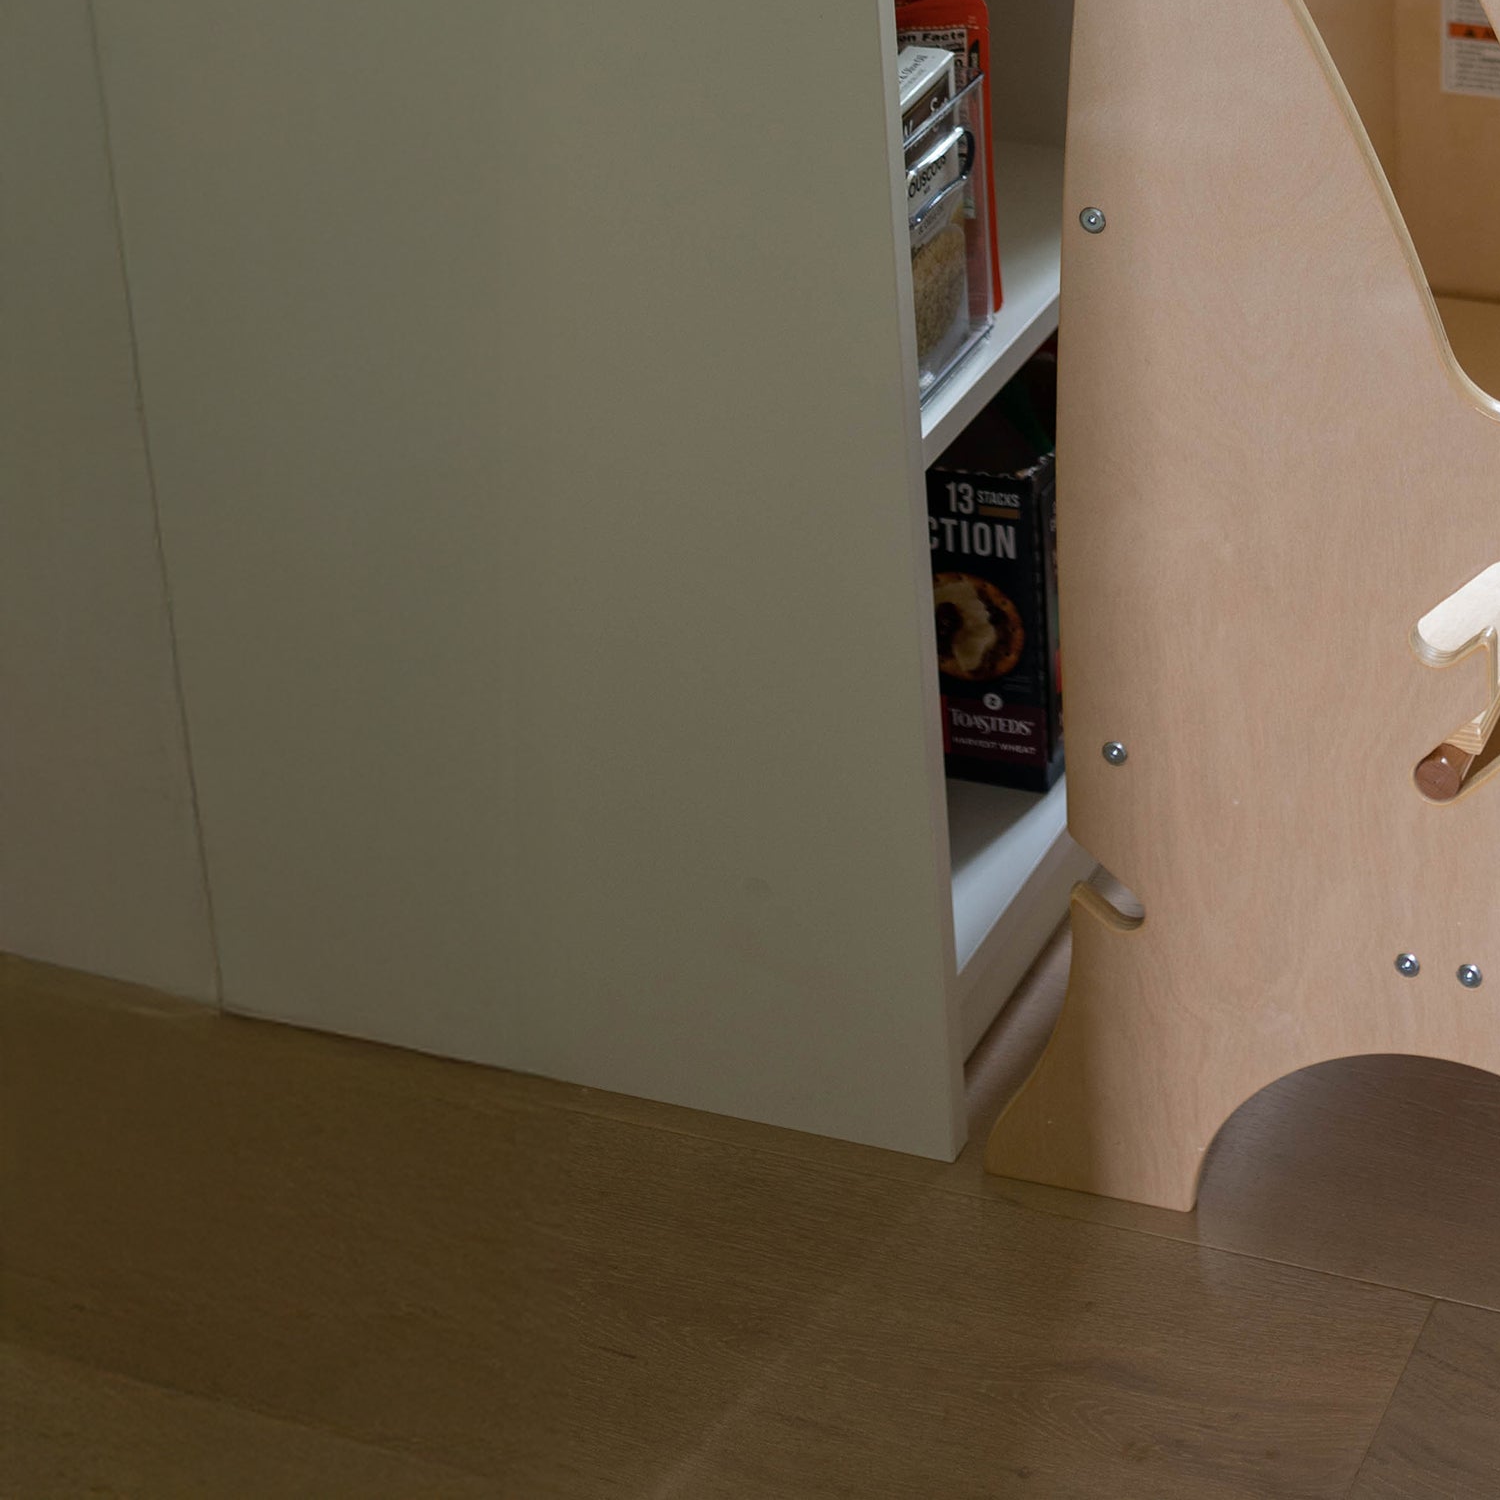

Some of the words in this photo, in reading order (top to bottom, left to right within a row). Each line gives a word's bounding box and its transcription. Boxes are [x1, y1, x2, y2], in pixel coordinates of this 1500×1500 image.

[922, 31, 965, 41] Facts
[945, 481, 975, 515] 13
[977, 490, 1021, 508] STACKS
